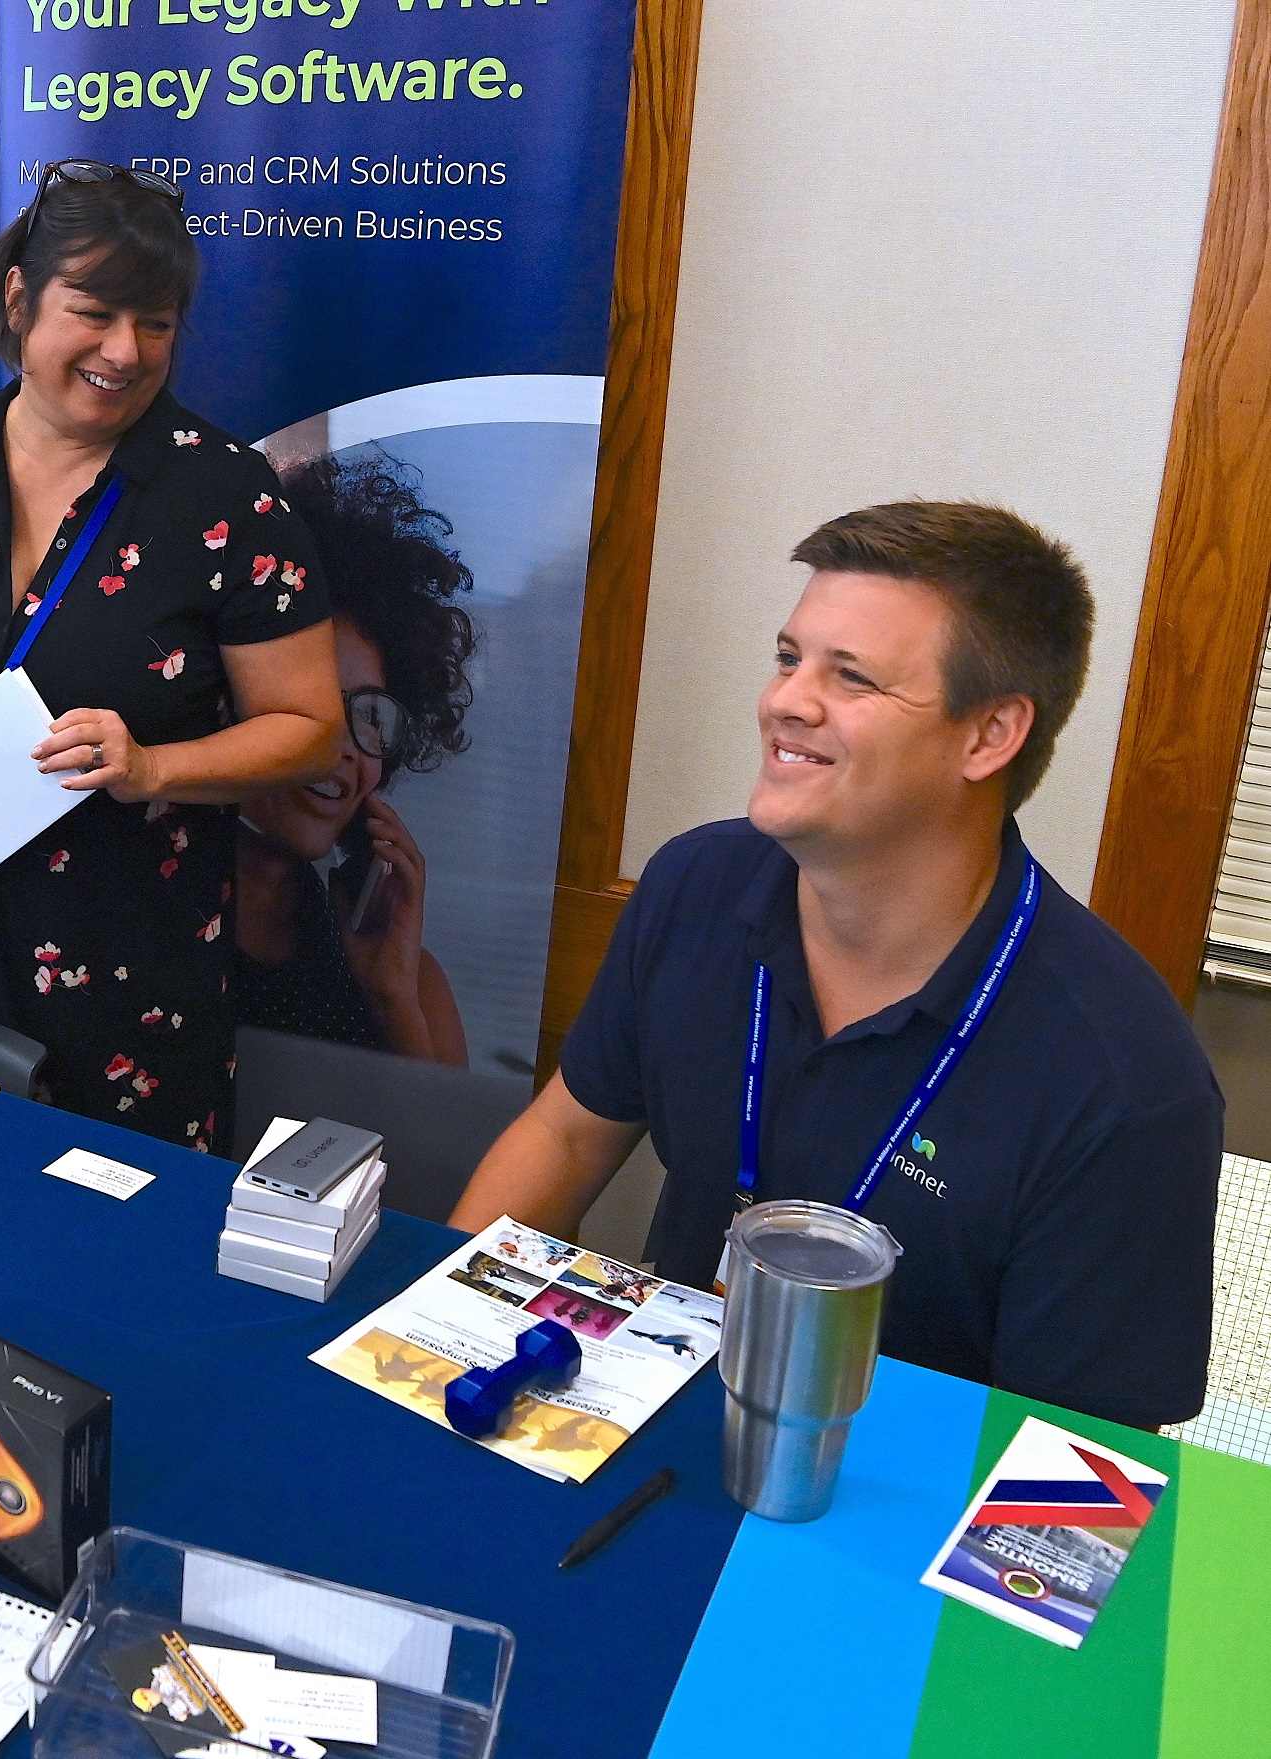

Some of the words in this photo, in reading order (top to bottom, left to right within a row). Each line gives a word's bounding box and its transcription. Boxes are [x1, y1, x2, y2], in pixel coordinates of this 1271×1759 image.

[26, 0, 130, 33] Your
[158, 0, 362, 34] Legacy
[23, 66, 212, 122] Legacy
[225, 49, 524, 106] Software.
[200, 155, 255, 185] and
[264, 156, 340, 185] CRM
[350, 154, 507, 185] Solutions
[180, 208, 344, 238] ect-Driven
[355, 210, 503, 242] Business
[957, 1020, 973, 1039] North
[968, 993, 988, 1020] Carolina
[982, 967, 1001, 993] Military
[995, 937, 1015, 968] Business
[1010, 915, 1024, 938] Center
[854, 1183, 867, 1201] North
[864, 1162, 880, 1185] Carolina
[877, 1141, 893, 1164] Military
[889, 1116, 909, 1143] Business
[906, 1097, 922, 1118] Center
[926, 1046, 956, 1089] www.ncmbc.us
[405, 1332, 478, 1369] Symposium
[555, 1397, 611, 1417] Defense
[983, 1539, 1091, 1592] SIMONTIC
